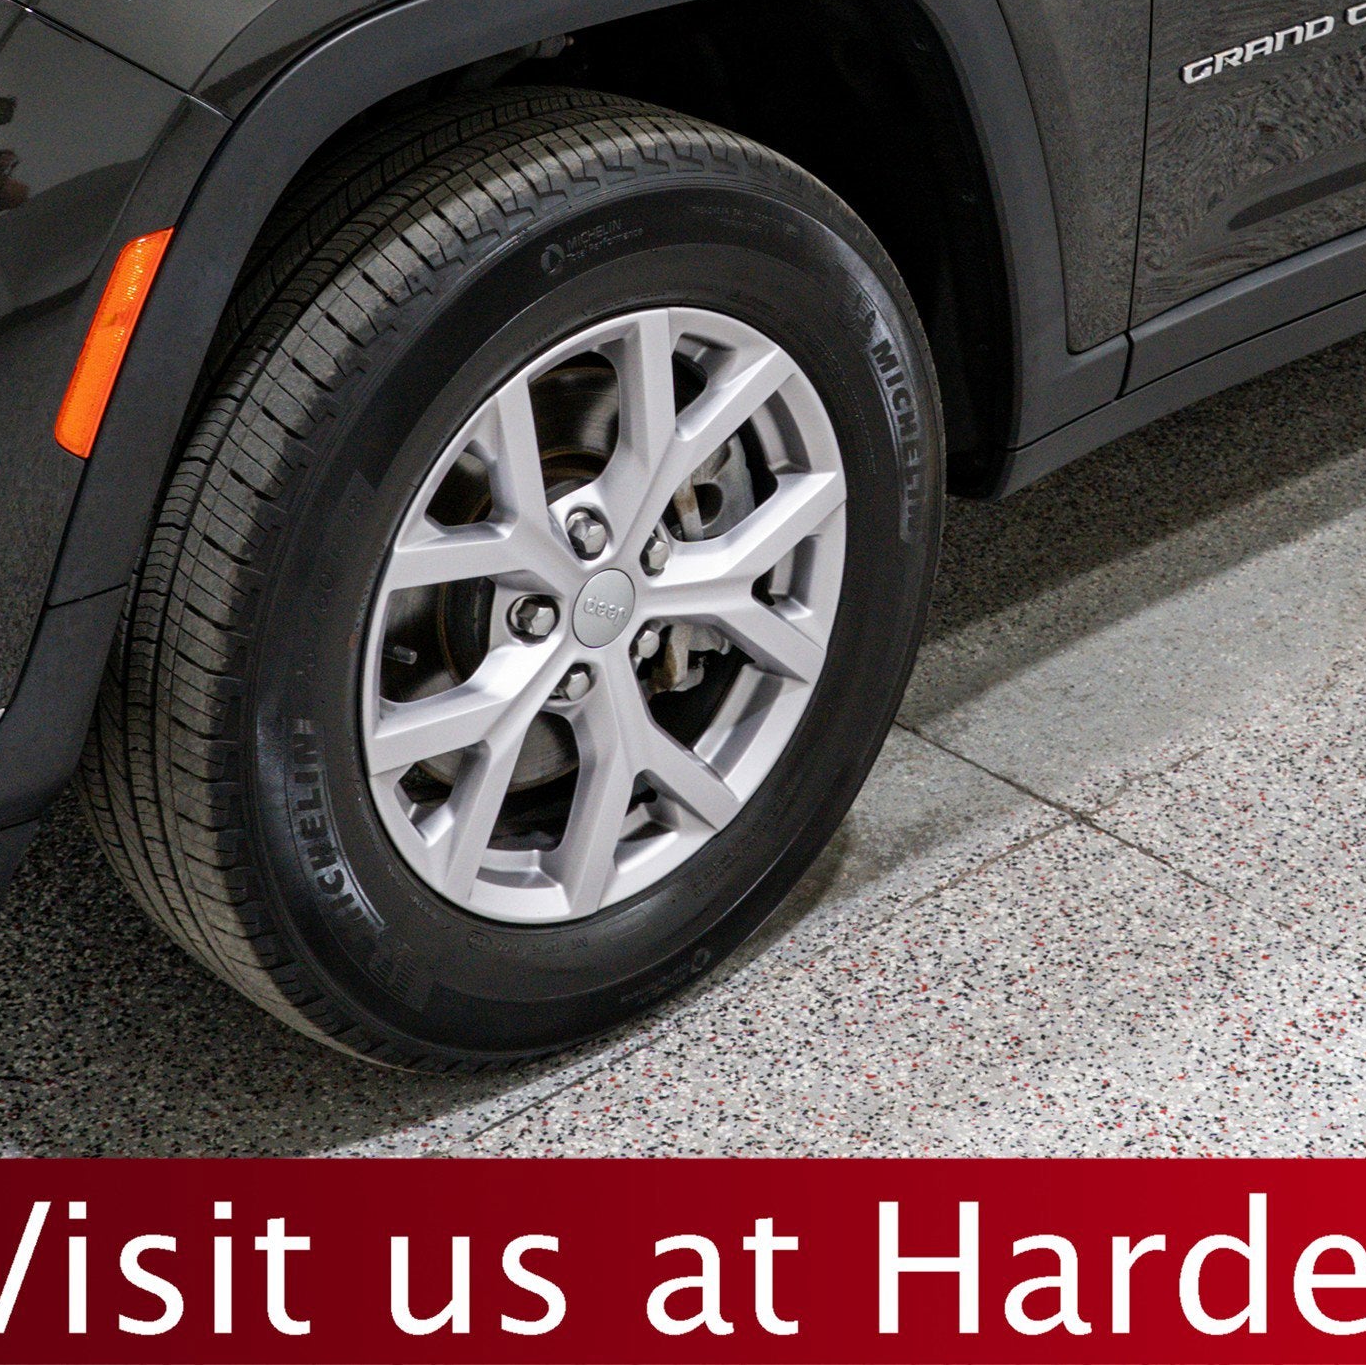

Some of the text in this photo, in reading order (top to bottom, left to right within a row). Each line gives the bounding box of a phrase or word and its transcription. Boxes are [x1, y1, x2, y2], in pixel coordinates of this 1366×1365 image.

[1182, 15, 1334, 85] GRAND
[870, 338, 922, 534] MICHELIN
[584, 596, 627, 626] Jeep
